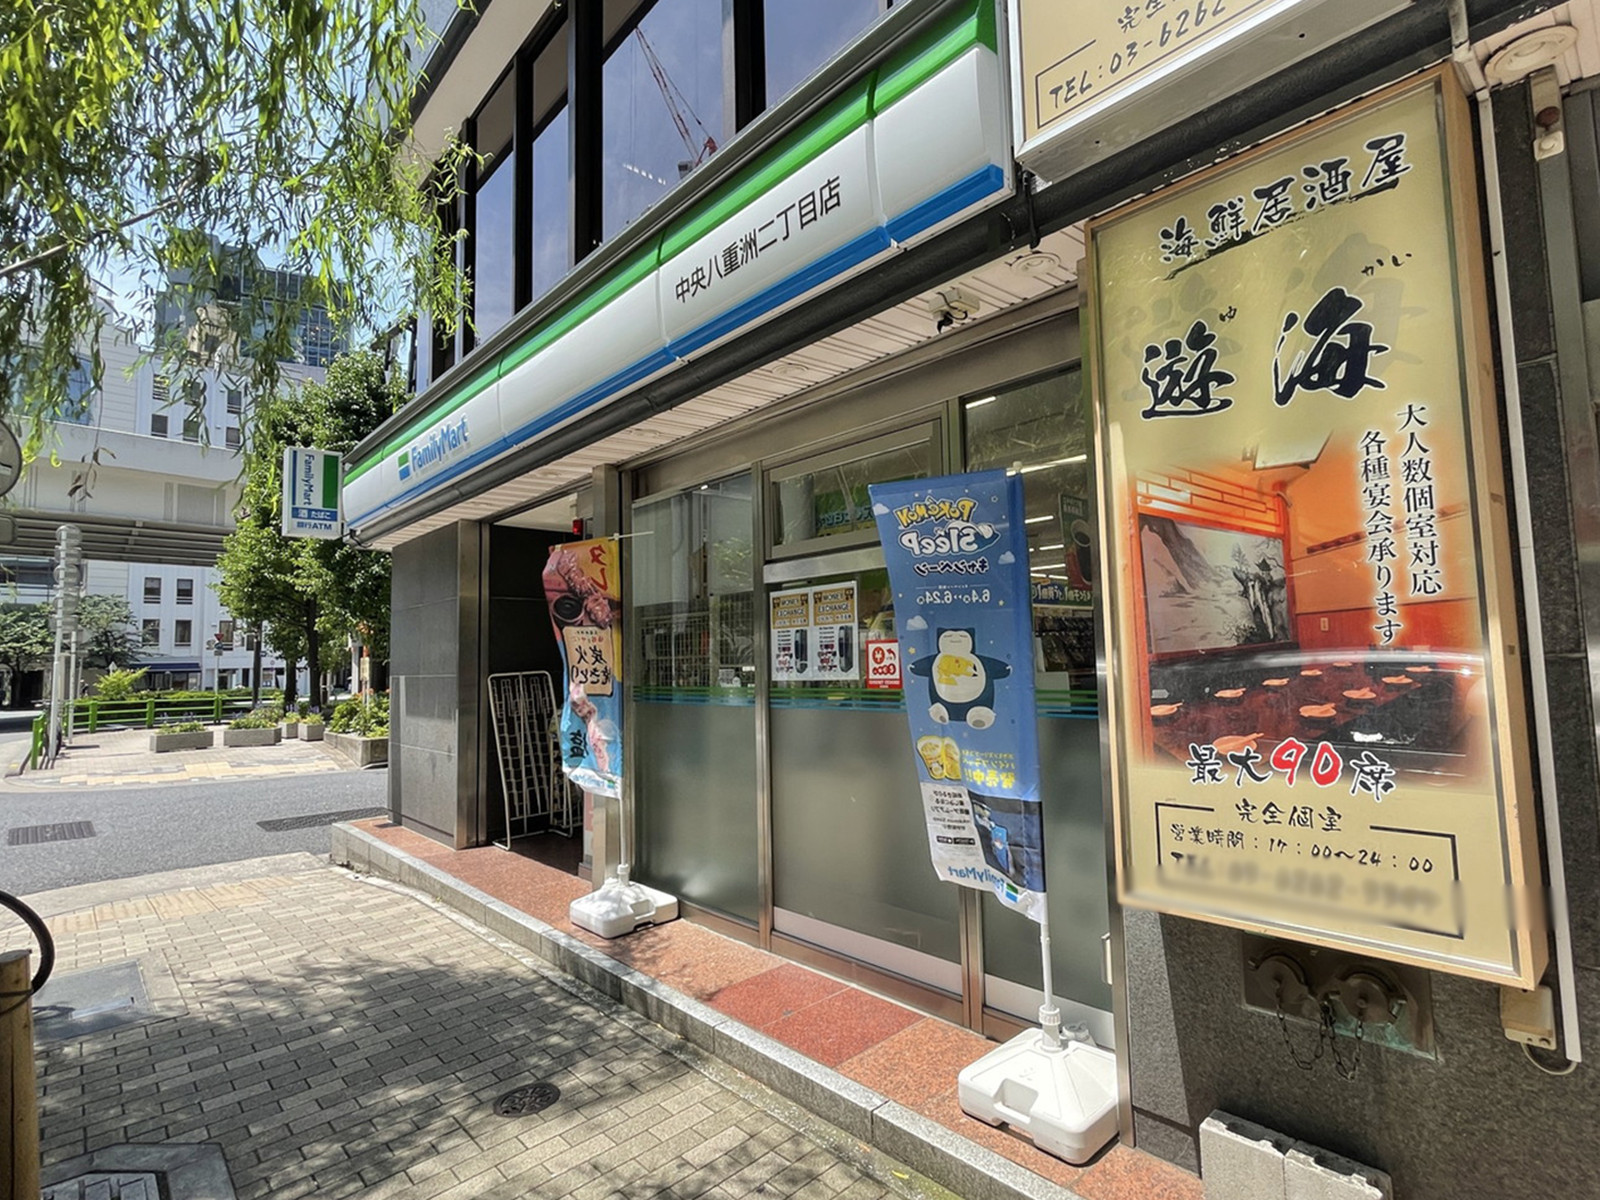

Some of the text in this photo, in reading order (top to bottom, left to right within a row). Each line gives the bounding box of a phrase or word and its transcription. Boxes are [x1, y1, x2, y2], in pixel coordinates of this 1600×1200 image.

[1159, 135, 1412, 263] 海鮮居酒屋
[675, 175, 841, 303] 中央八重洲二丁目店
[411, 415, 469, 472] FamilyMart
[303, 453, 315, 506] FamilyMart
[1397, 403, 1443, 596] 大人数個室対応
[311, 510, 331, 520] たばこ
[1360, 429, 1402, 646] 各種宴会承ります
[1186, 737, 1397, 802] 最大90席
[1235, 798, 1344, 833] 完全個室
